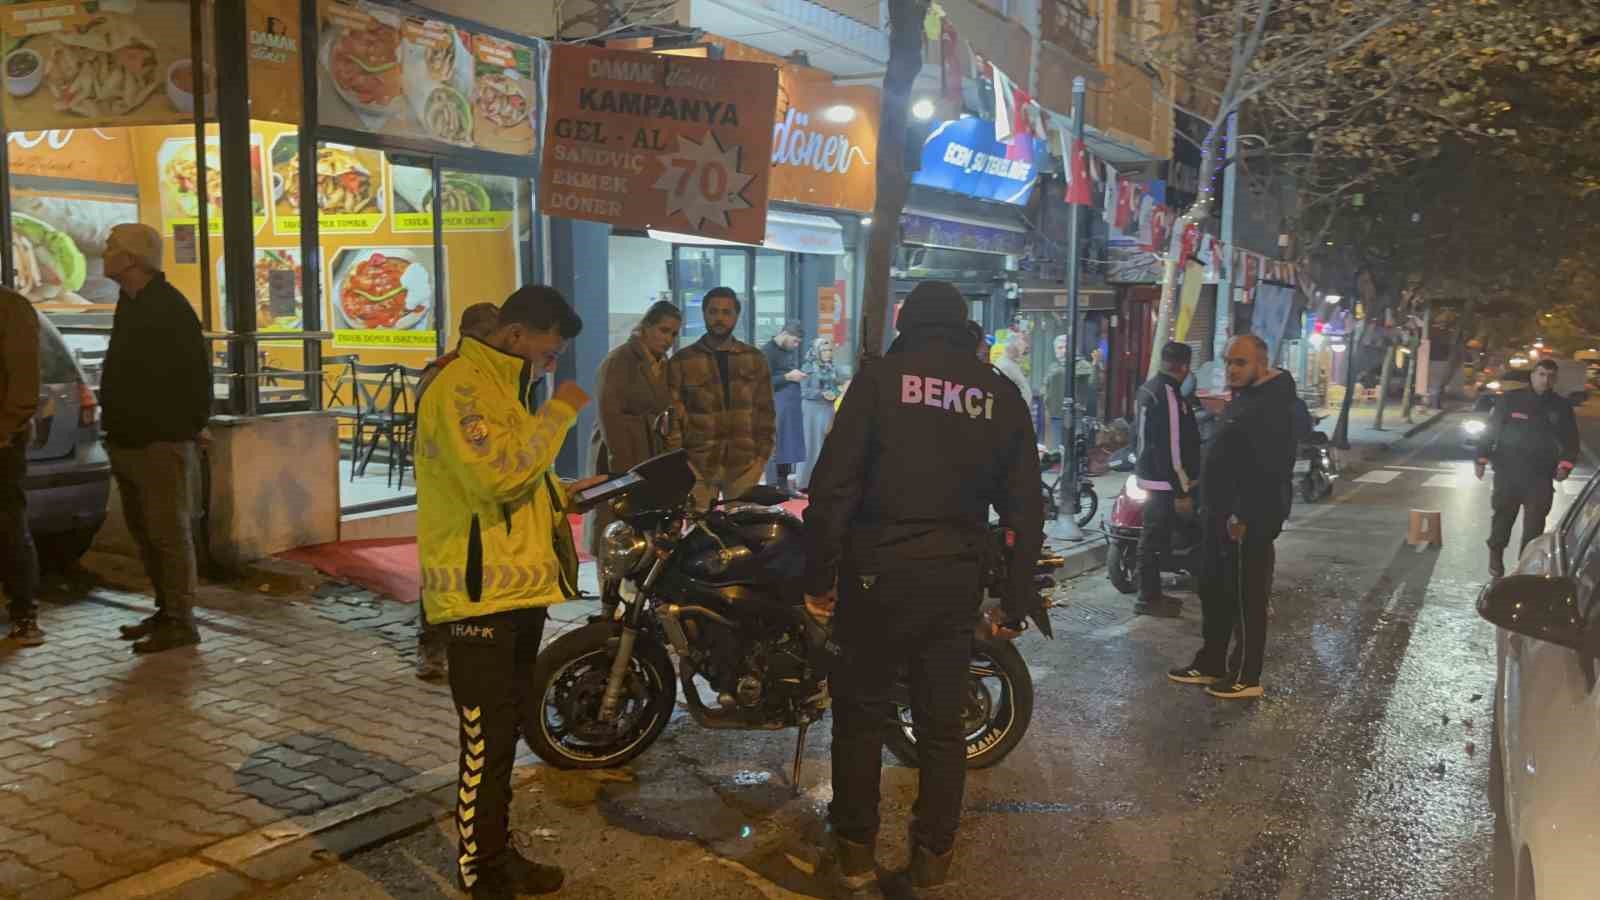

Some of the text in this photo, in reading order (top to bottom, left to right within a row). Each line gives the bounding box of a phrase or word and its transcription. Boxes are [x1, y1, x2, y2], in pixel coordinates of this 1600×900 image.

[589, 58, 655, 82] DAMAK
[578, 87, 739, 127] KAMPANYA
[554, 118, 608, 144] GEL
[632, 127, 666, 151] AL
[771, 107, 871, 174] döner
[551, 168, 629, 194] EKMEK
[671, 158, 728, 203] 70
[966, 728, 1002, 754] MAHA
